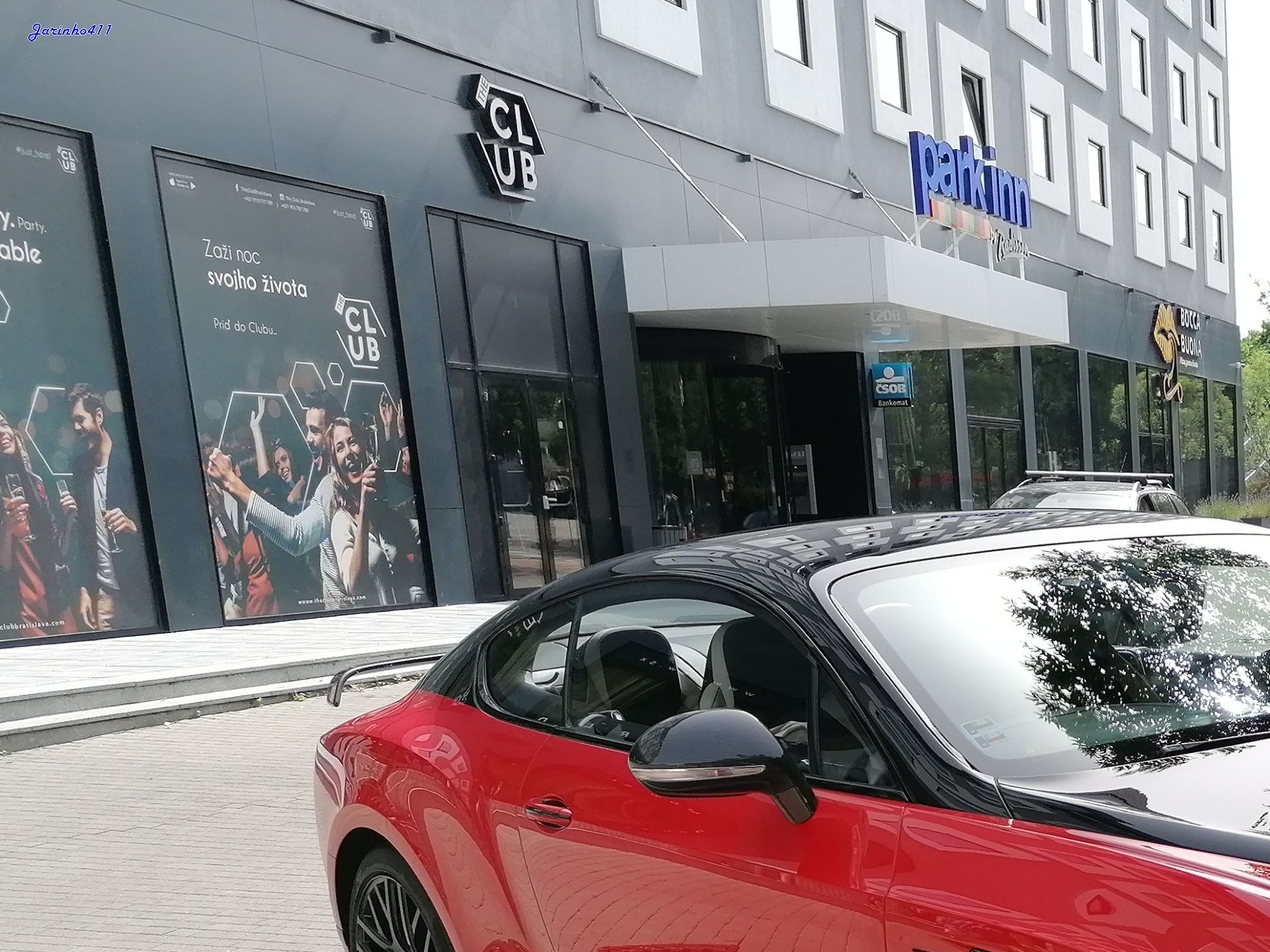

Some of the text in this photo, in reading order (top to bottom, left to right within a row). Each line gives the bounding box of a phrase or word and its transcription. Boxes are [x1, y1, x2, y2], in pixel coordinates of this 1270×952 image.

[477, 77, 489, 104] THE
[17, 216, 47, 235] Party.
[202, 238, 261, 265] Zaži noc
[208, 269, 308, 298] svojho života
[234, 320, 246, 332] do
[1181, 307, 1201, 331] BOCCA
[1181, 334, 1203, 357] BUONA
[875, 383, 906, 394] ČSOB
